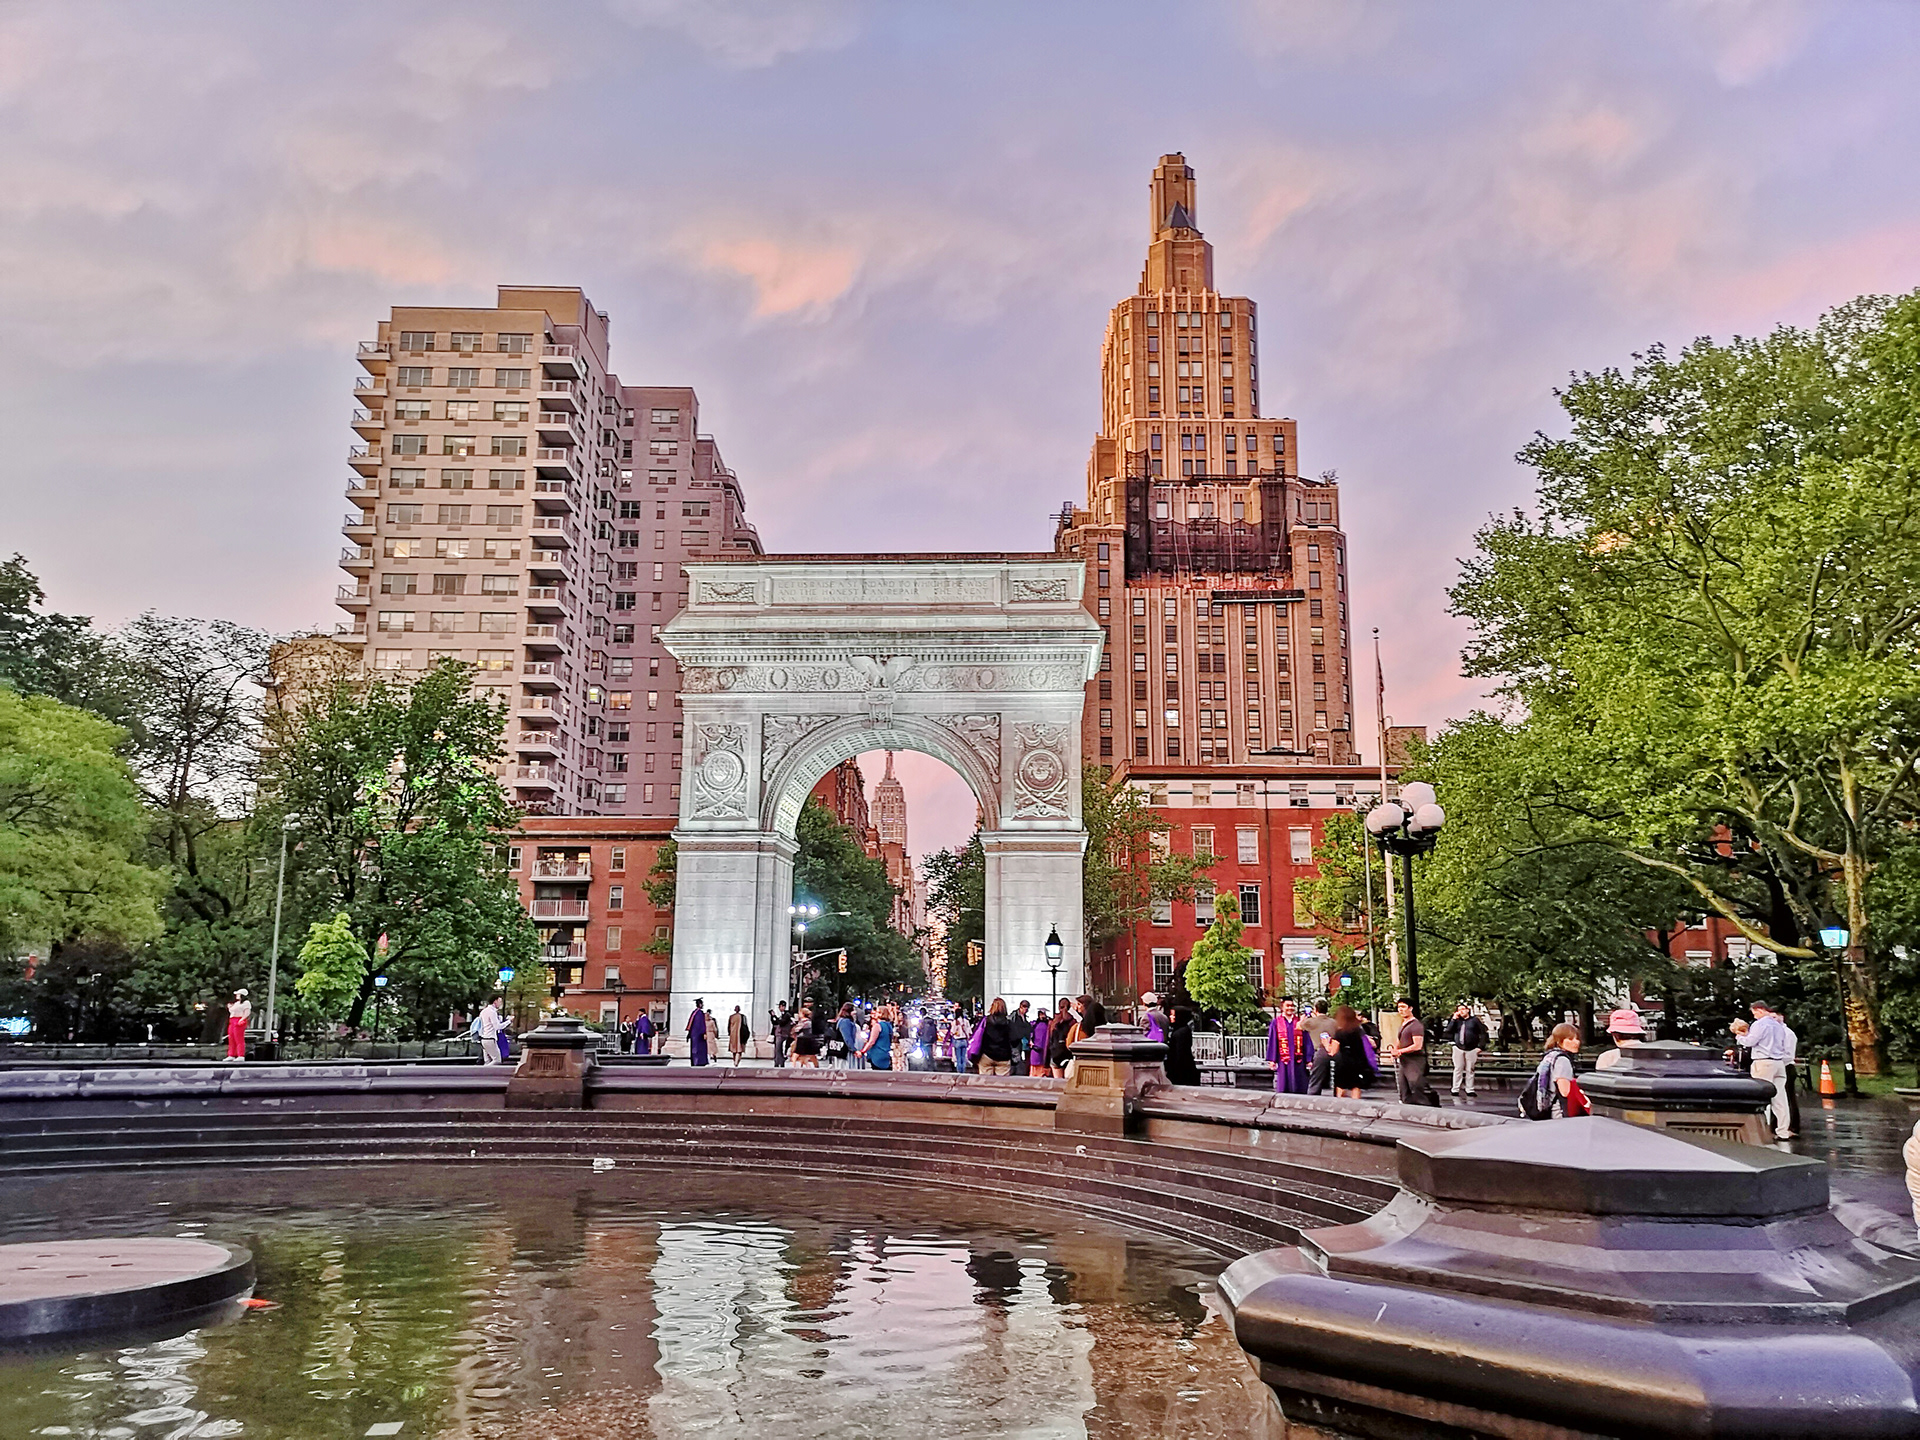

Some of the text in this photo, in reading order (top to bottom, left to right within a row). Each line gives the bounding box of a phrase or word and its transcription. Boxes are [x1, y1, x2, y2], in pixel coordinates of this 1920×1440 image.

[797, 581, 808, 589] US
[847, 580, 896, 588] STNDARD
[898, 580, 911, 588] TO
[777, 588, 797, 596] AND
[799, 588, 817, 596] THE
[822, 588, 859, 596] HONEST
[887, 588, 920, 596] REPAIR
[957, 587, 989, 595] EVENT
